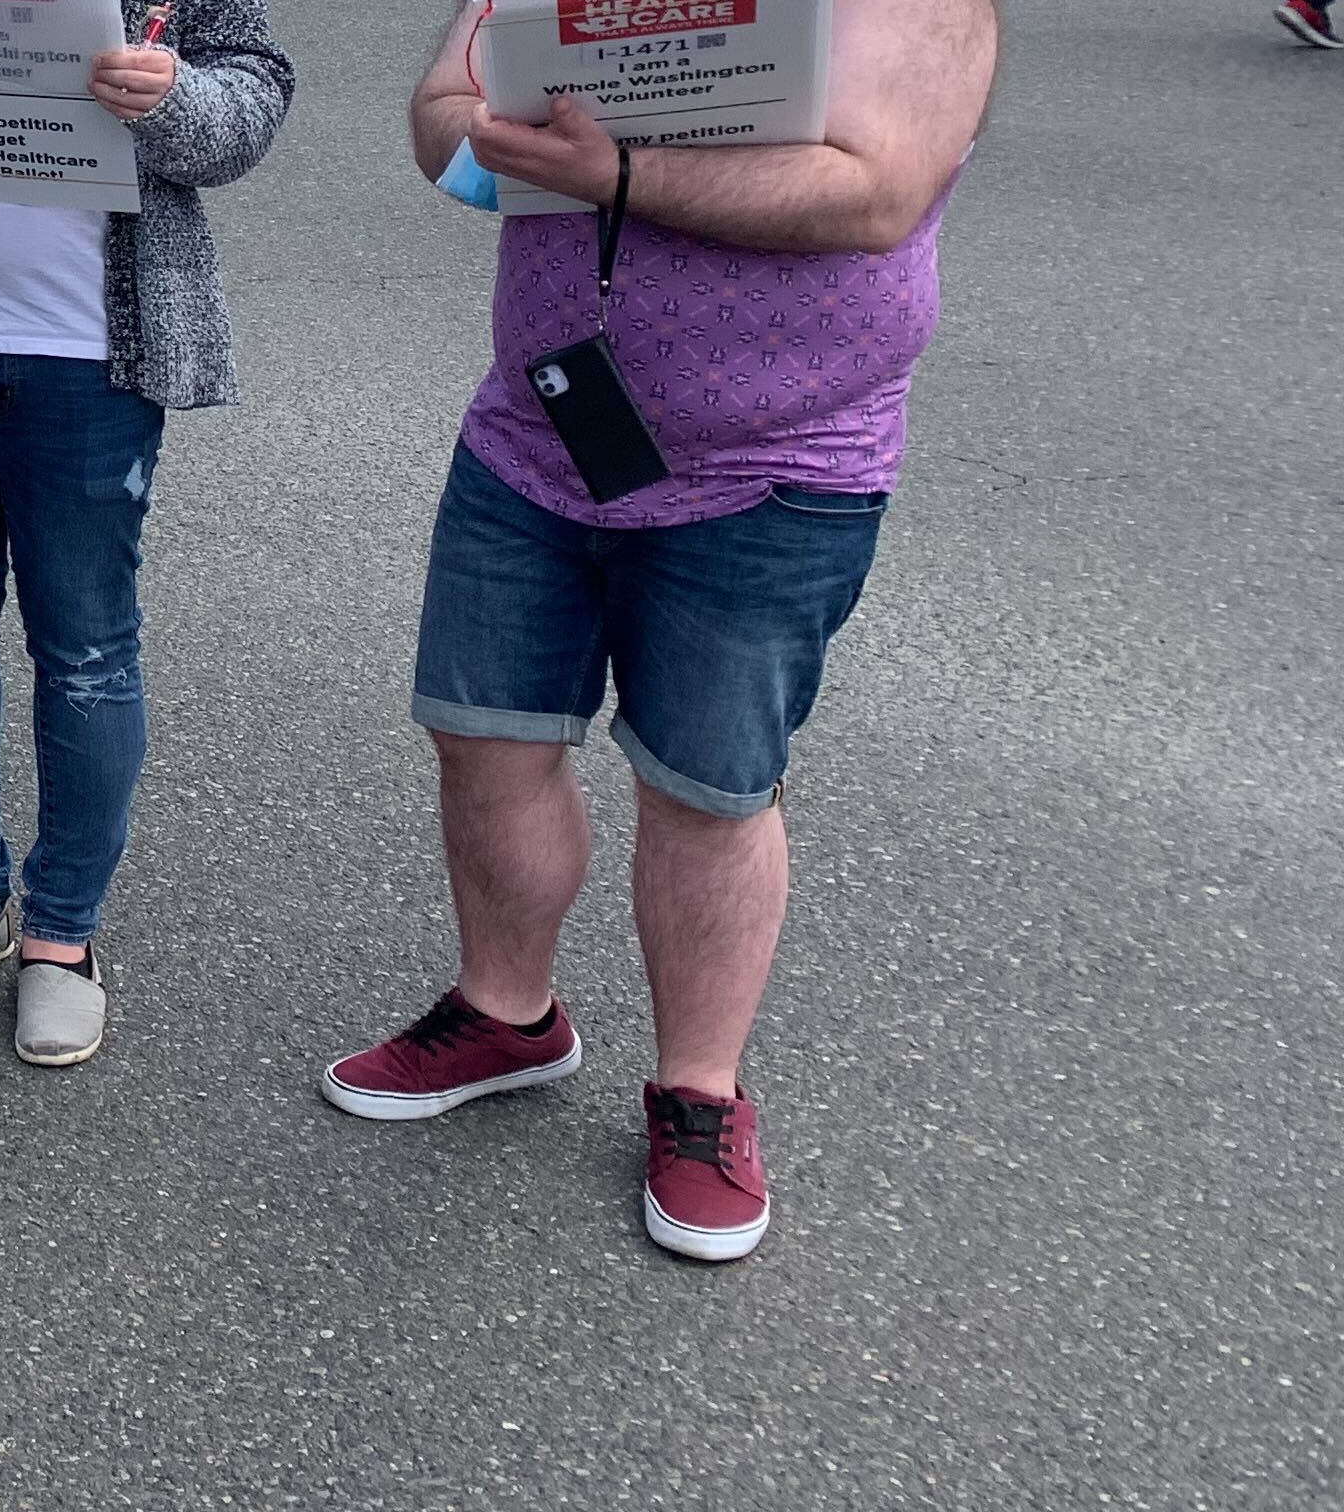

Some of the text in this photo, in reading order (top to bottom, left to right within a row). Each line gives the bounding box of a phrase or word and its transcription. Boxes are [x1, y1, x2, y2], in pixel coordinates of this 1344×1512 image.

[631, 1, 735, 26] CARE
[640, 21, 695, 35] ALWAYS
[598, 39, 690, 60] I-1471
[619, 57, 690, 74] I am a
[543, 63, 776, 96] Whole Washington
[597, 84, 715, 105] Volunteer
[618, 123, 756, 147] my petition
